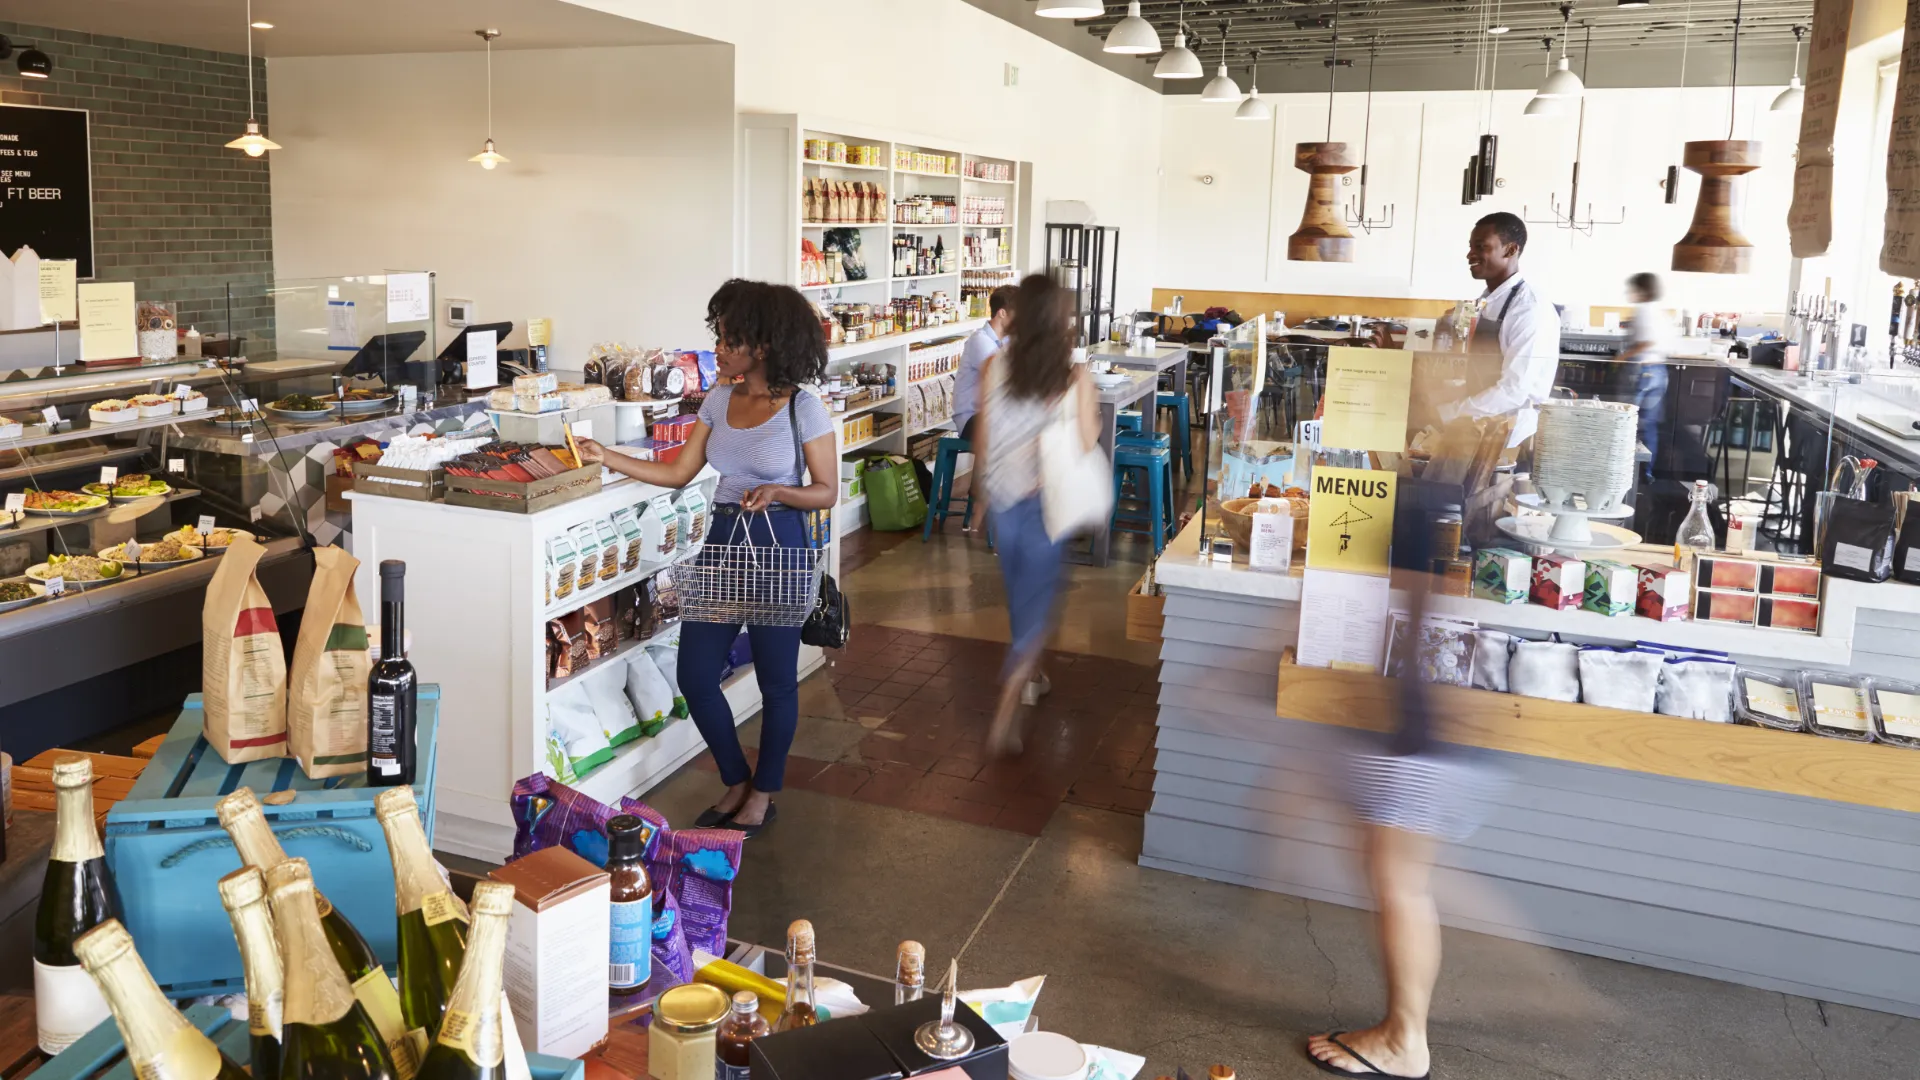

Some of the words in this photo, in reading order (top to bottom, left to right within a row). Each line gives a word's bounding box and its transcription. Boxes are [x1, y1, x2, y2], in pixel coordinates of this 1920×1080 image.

[23, 149, 38, 157] TEAS
[28, 187, 61, 200] BEER
[1316, 476, 1388, 499] MENUS
